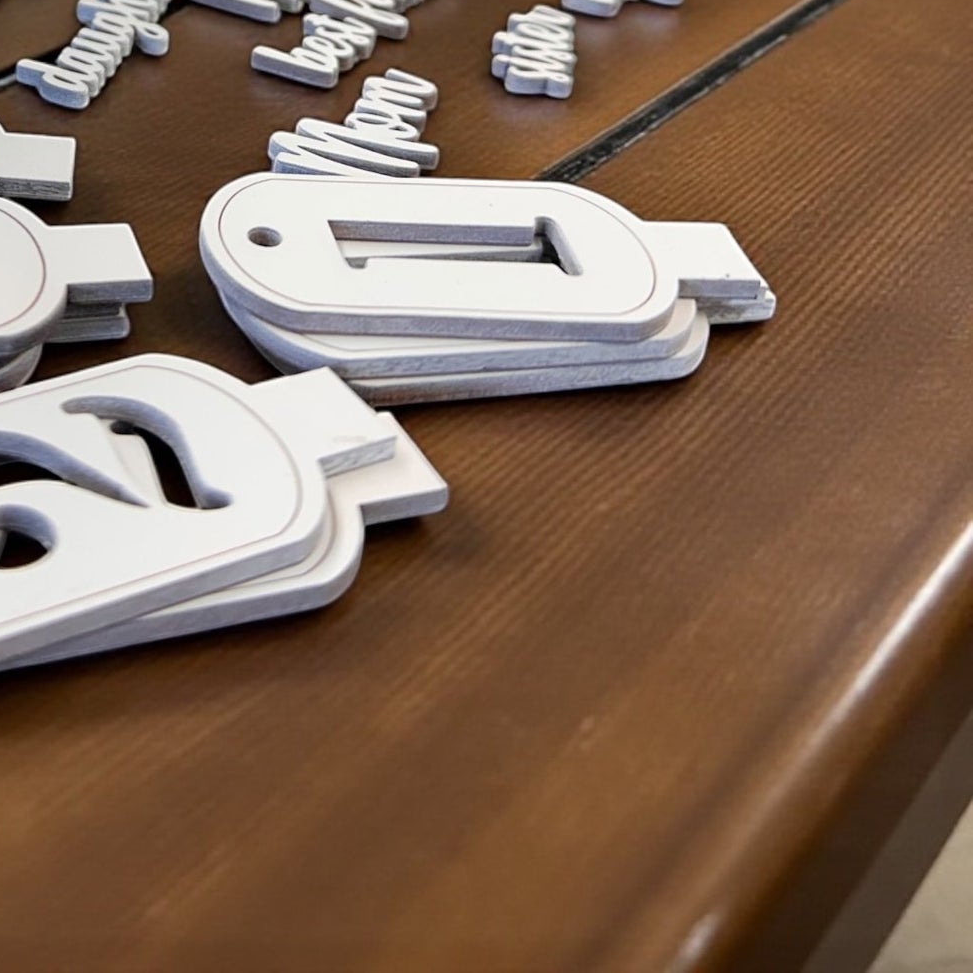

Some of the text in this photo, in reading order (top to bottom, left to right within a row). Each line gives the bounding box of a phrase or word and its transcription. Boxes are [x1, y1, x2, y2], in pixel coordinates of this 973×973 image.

[251, 13, 377, 88] best
[491, 4, 577, 100] sister
[268, 68, 440, 177] Mom
